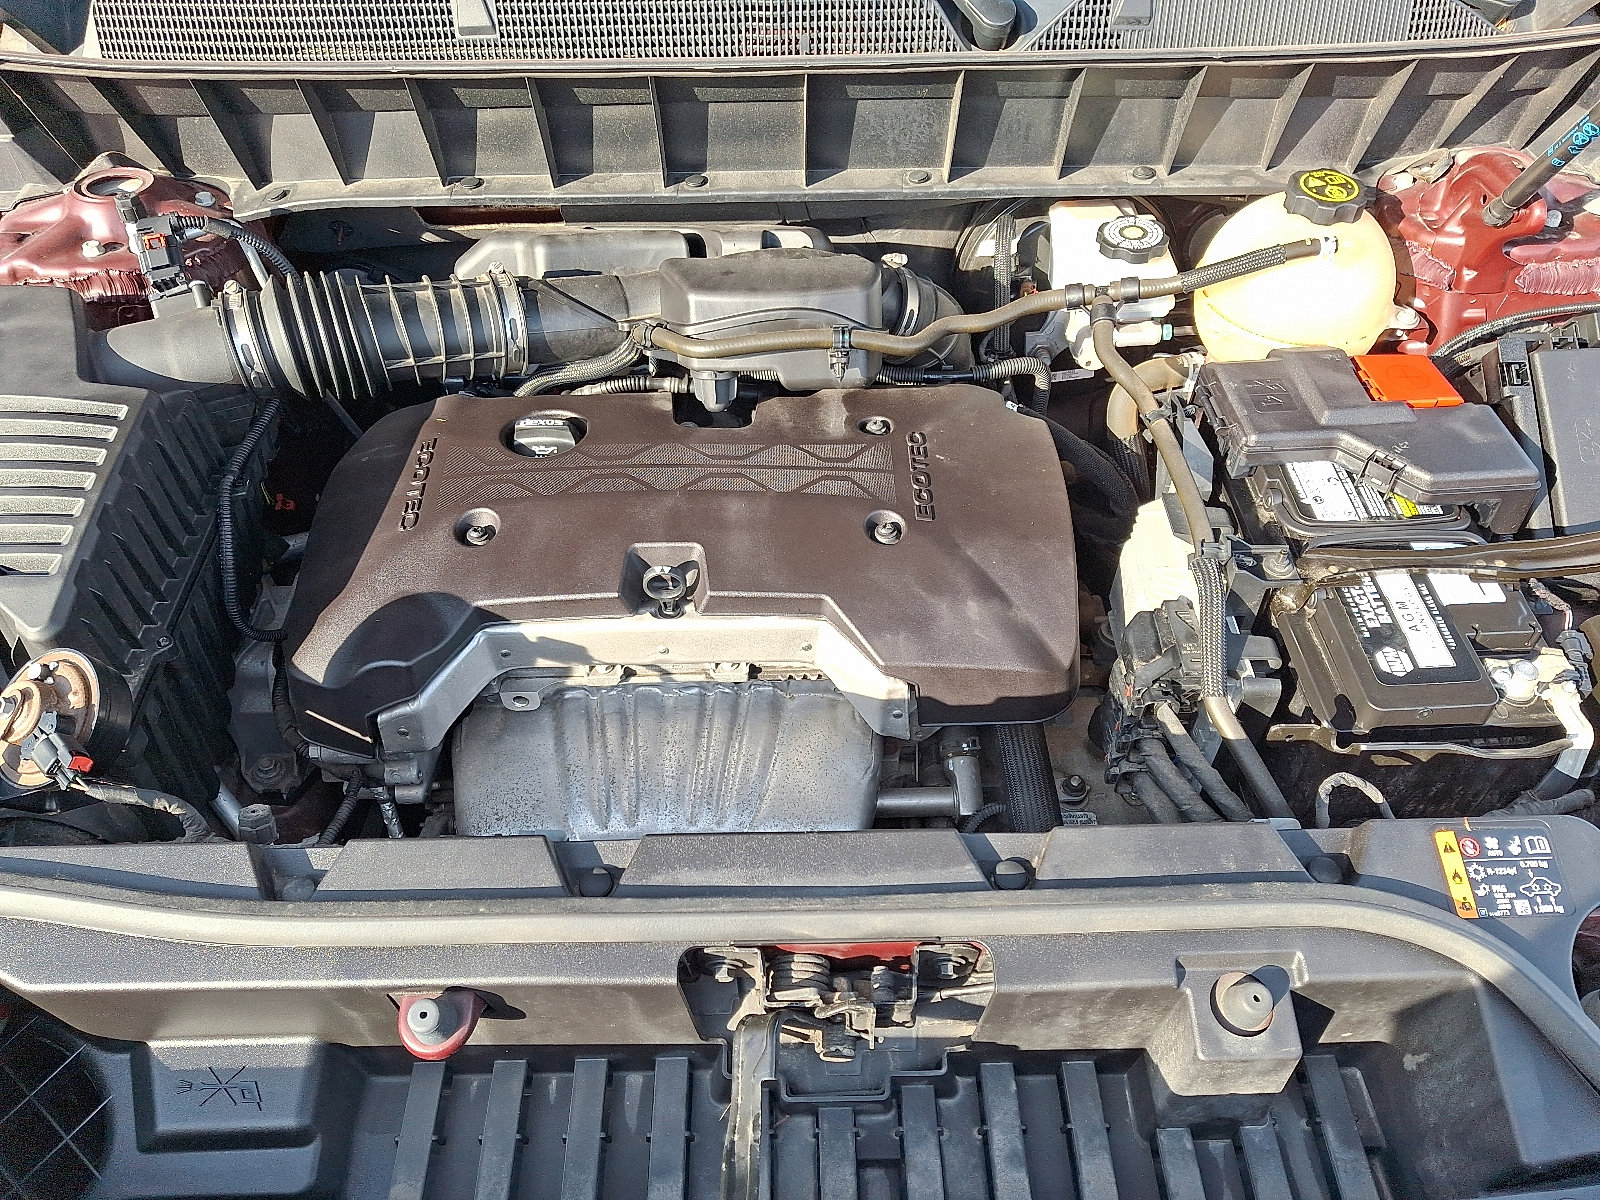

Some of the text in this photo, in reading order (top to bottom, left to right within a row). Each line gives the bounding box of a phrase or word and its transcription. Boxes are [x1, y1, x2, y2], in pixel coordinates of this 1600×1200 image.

[519, 418, 564, 426] dexos
[399, 437, 438, 532] ECOTEC
[905, 431, 936, 522] ECOTEC
[1341, 587, 1371, 638] MAINTENANC
[1361, 574, 1393, 624] BATTER
[1395, 601, 1421, 632] AGM
